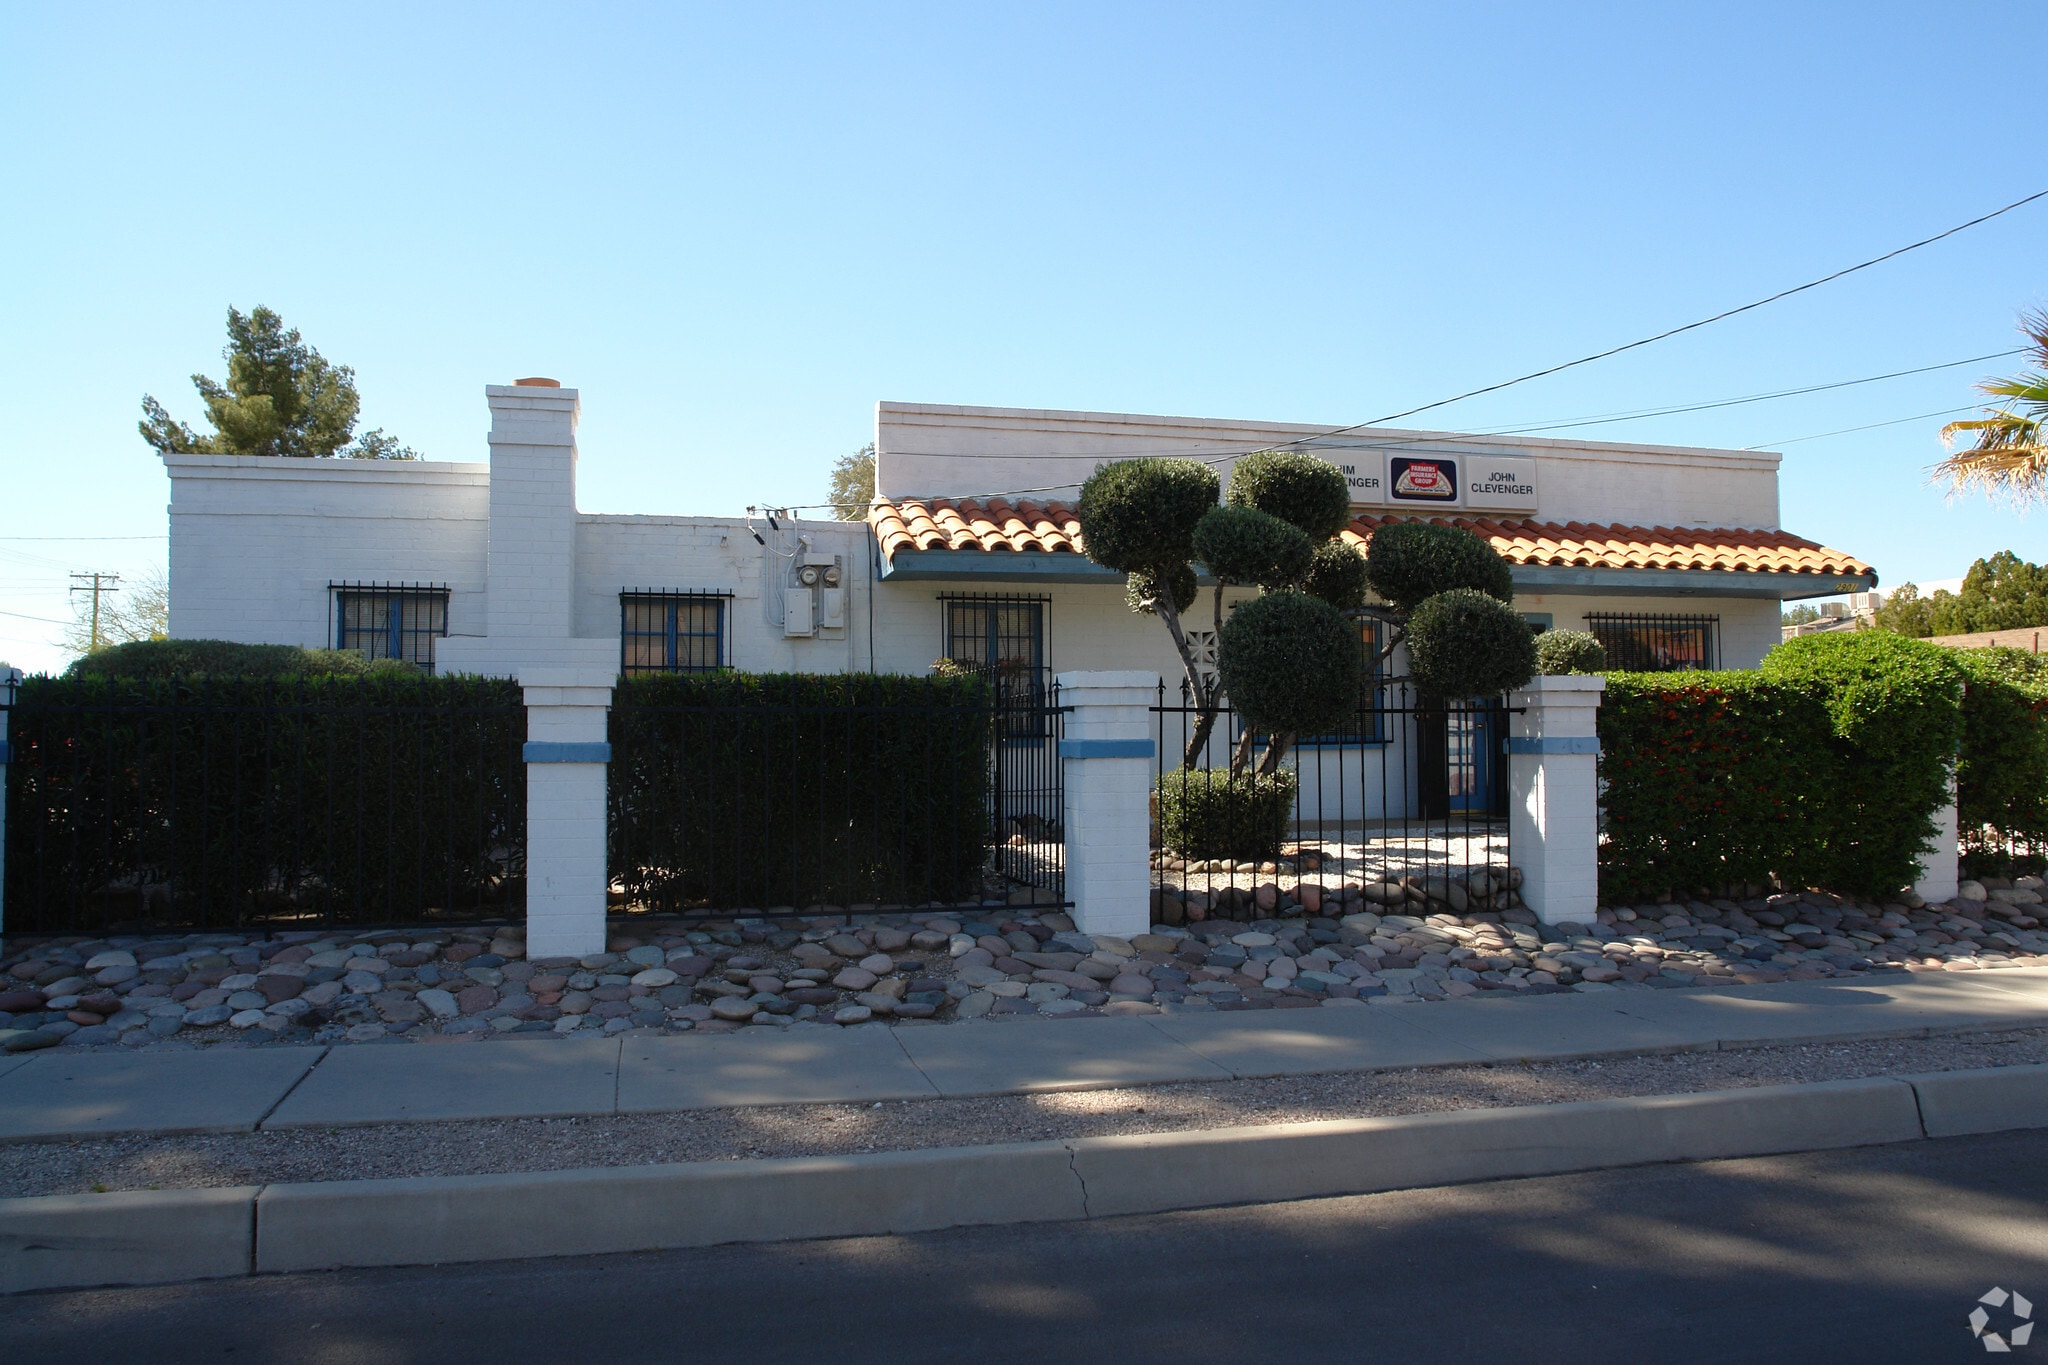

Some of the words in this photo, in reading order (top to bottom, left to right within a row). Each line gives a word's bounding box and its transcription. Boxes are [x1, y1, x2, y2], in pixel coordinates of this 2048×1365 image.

[1411, 465, 1436, 473] FARMERS
[1414, 477, 1433, 485] GROUP
[1488, 472, 1516, 482] JOHN
[1471, 483, 1534, 495] CLEVENGER
[1835, 583, 1858, 592] 2901
